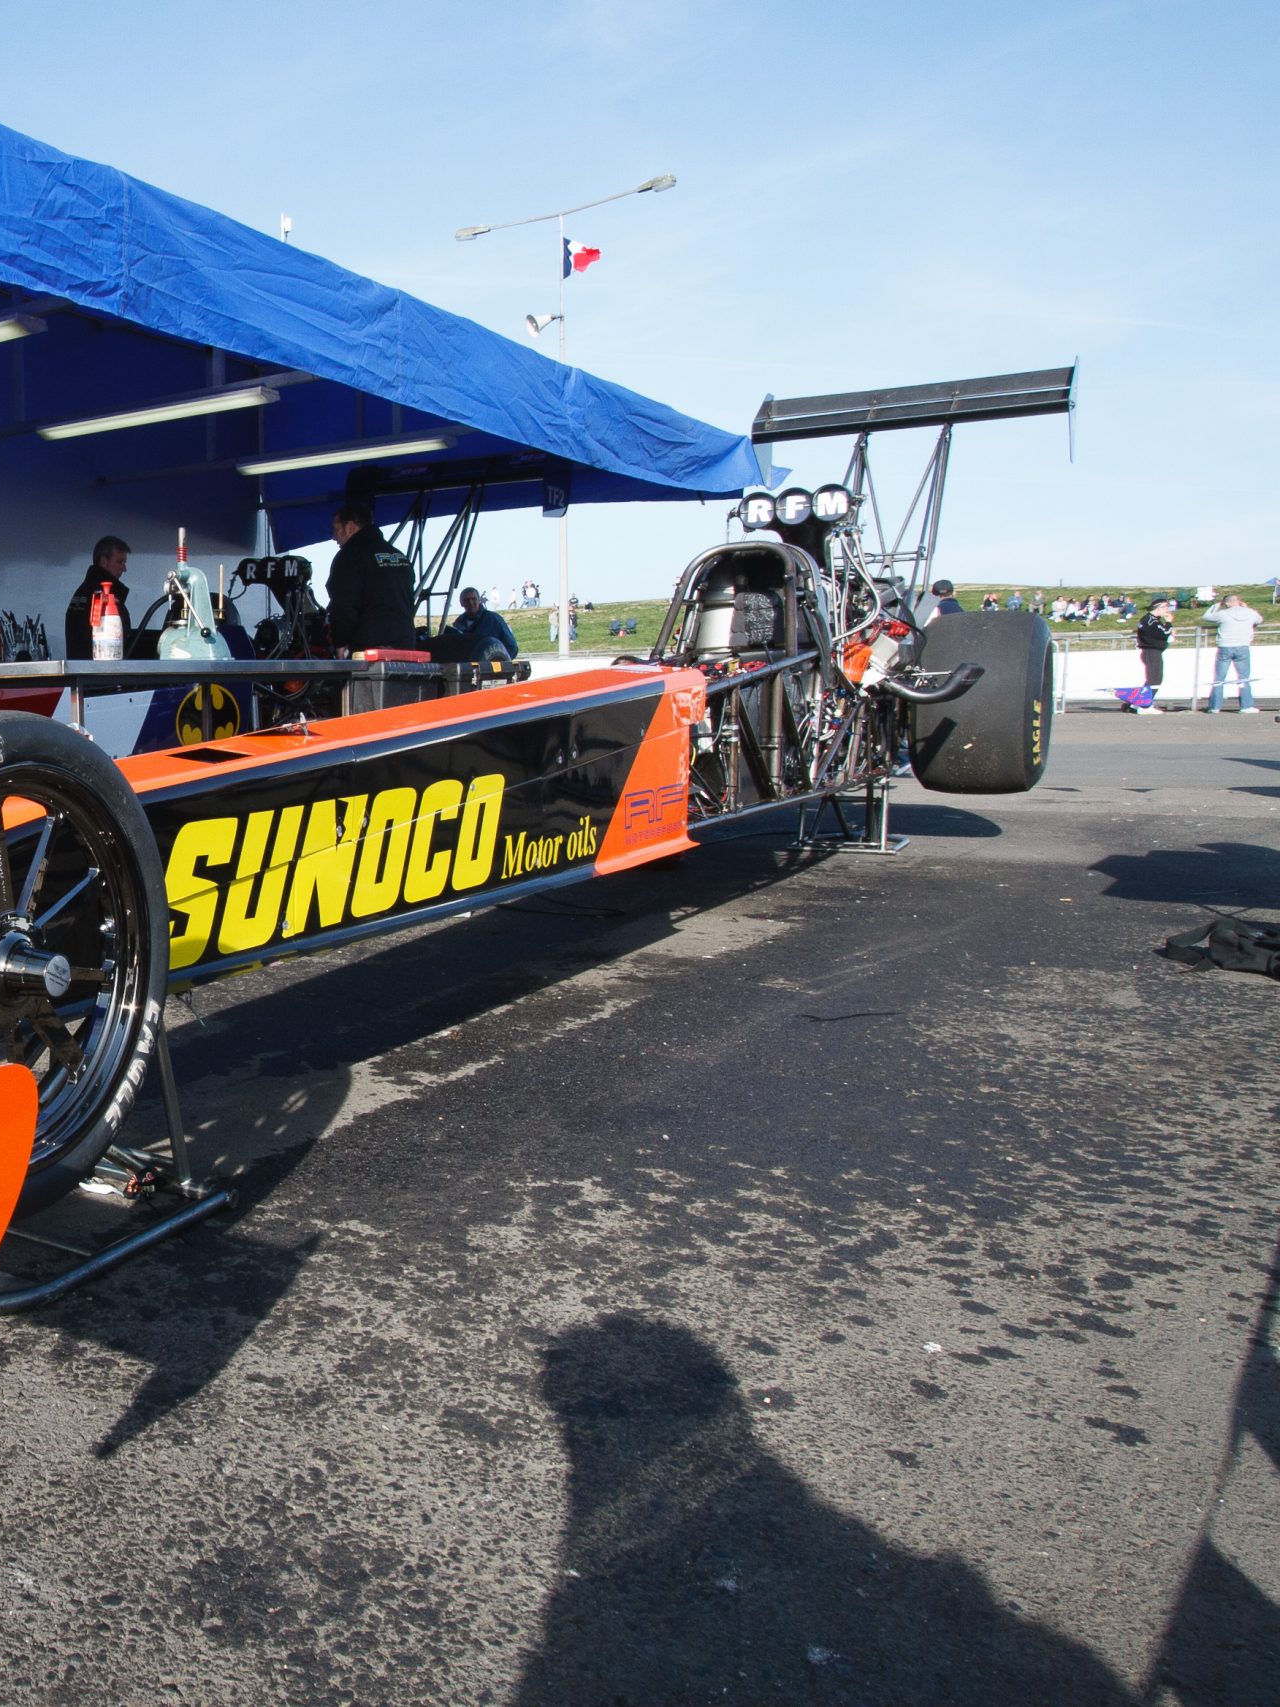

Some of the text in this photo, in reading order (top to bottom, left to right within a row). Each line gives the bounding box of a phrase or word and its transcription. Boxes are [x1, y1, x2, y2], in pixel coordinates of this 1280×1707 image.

[547, 485, 566, 508] TF2
[1032, 699, 1042, 766] EAGLE
[165, 773, 597, 970] SUNOCO Motor oils
